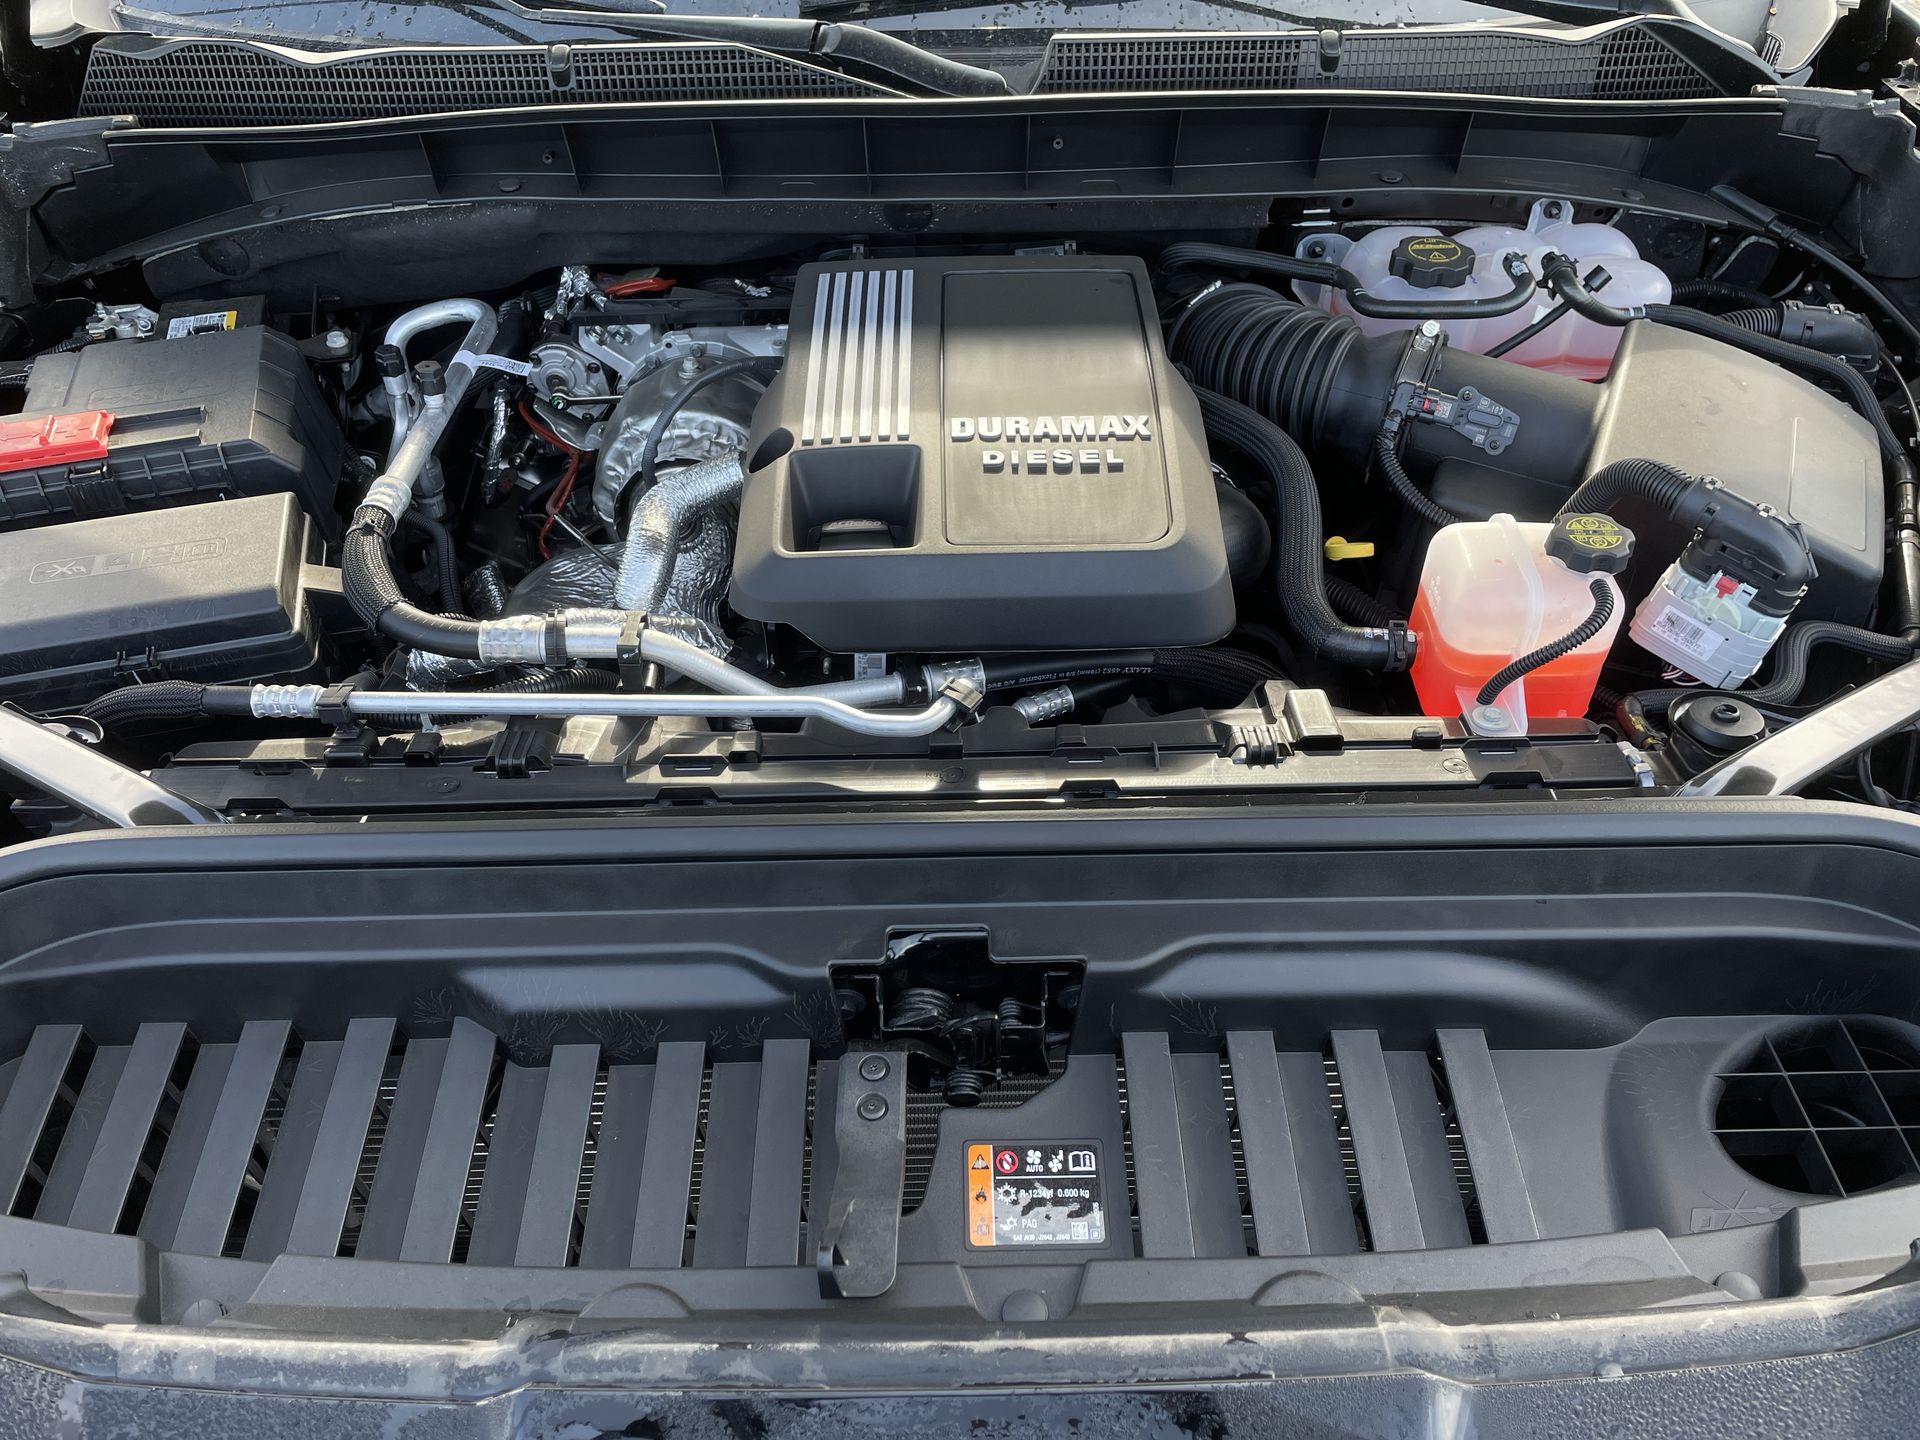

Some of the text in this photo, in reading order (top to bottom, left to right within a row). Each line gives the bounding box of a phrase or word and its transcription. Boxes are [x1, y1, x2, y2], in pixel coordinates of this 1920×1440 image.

[950, 415, 1152, 442] DURAMAX
[982, 449, 1124, 473] DIESEL
[1026, 1164, 1044, 1173] AUTO
[1020, 1188, 1090, 1199] R-1234yf 0.600 kg
[1022, 1218, 1038, 1228] PAG
